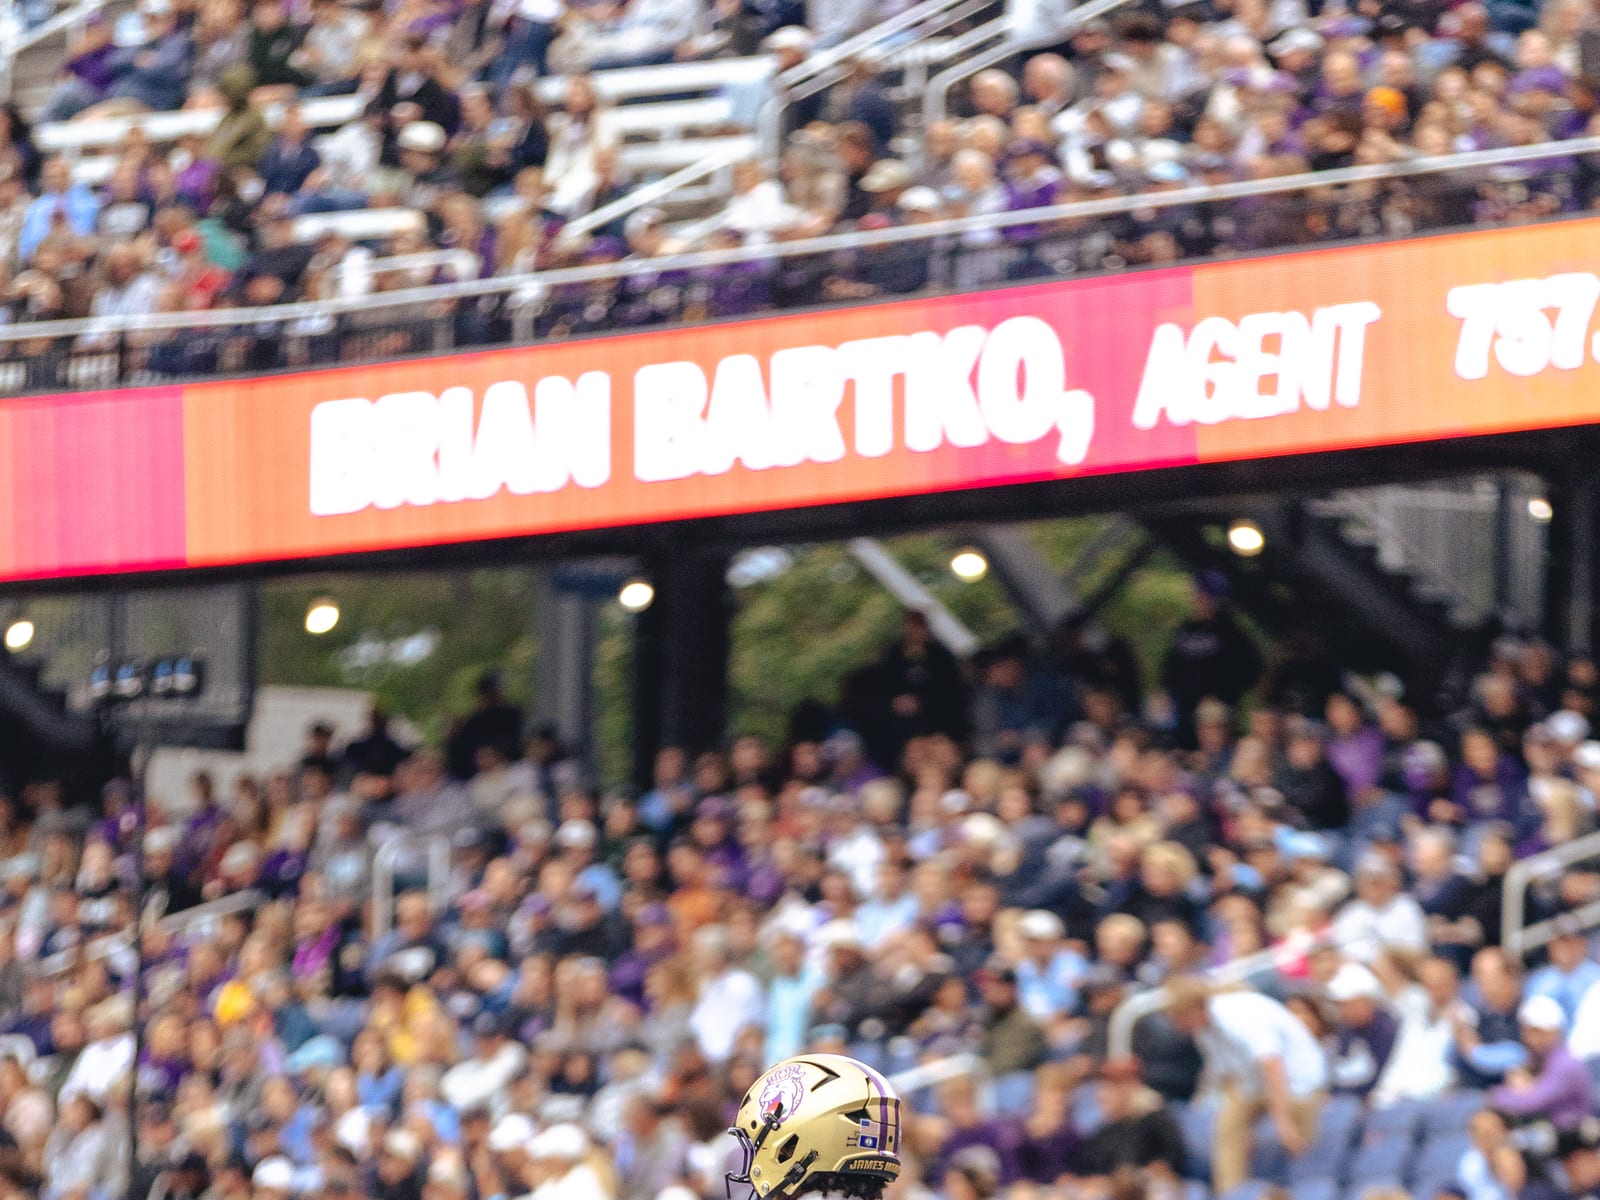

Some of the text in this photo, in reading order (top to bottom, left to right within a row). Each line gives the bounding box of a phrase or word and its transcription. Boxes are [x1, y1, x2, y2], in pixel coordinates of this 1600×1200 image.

[310, 272, 1600, 515] BRIAN BARTKO, AGENT 757
[850, 1160, 884, 1170] JAMES
